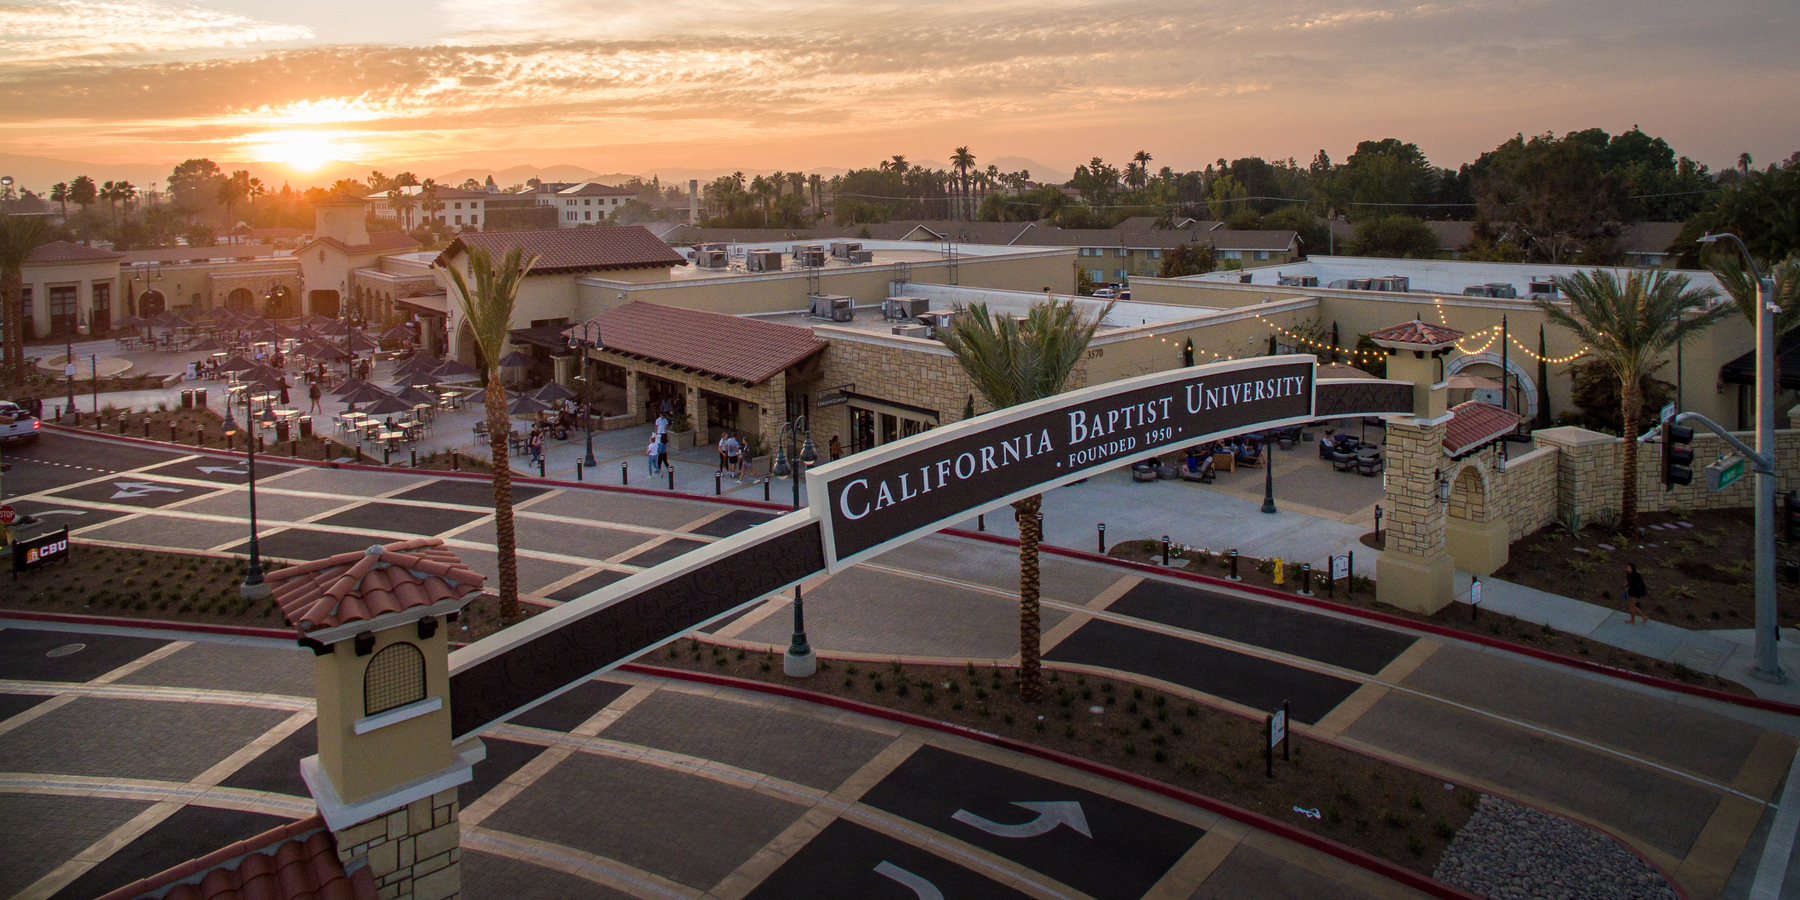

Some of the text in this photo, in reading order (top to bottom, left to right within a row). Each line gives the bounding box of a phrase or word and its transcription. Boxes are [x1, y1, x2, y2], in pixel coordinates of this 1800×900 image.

[1087, 348, 1103, 360] 3570
[840, 376, 1304, 520] CALIFORNIA BAPTIST UNIVERSITY
[1069, 426, 1172, 467] FOUNDED 1950
[0, 510, 14, 518] STOP
[40, 539, 67, 557] CBU
